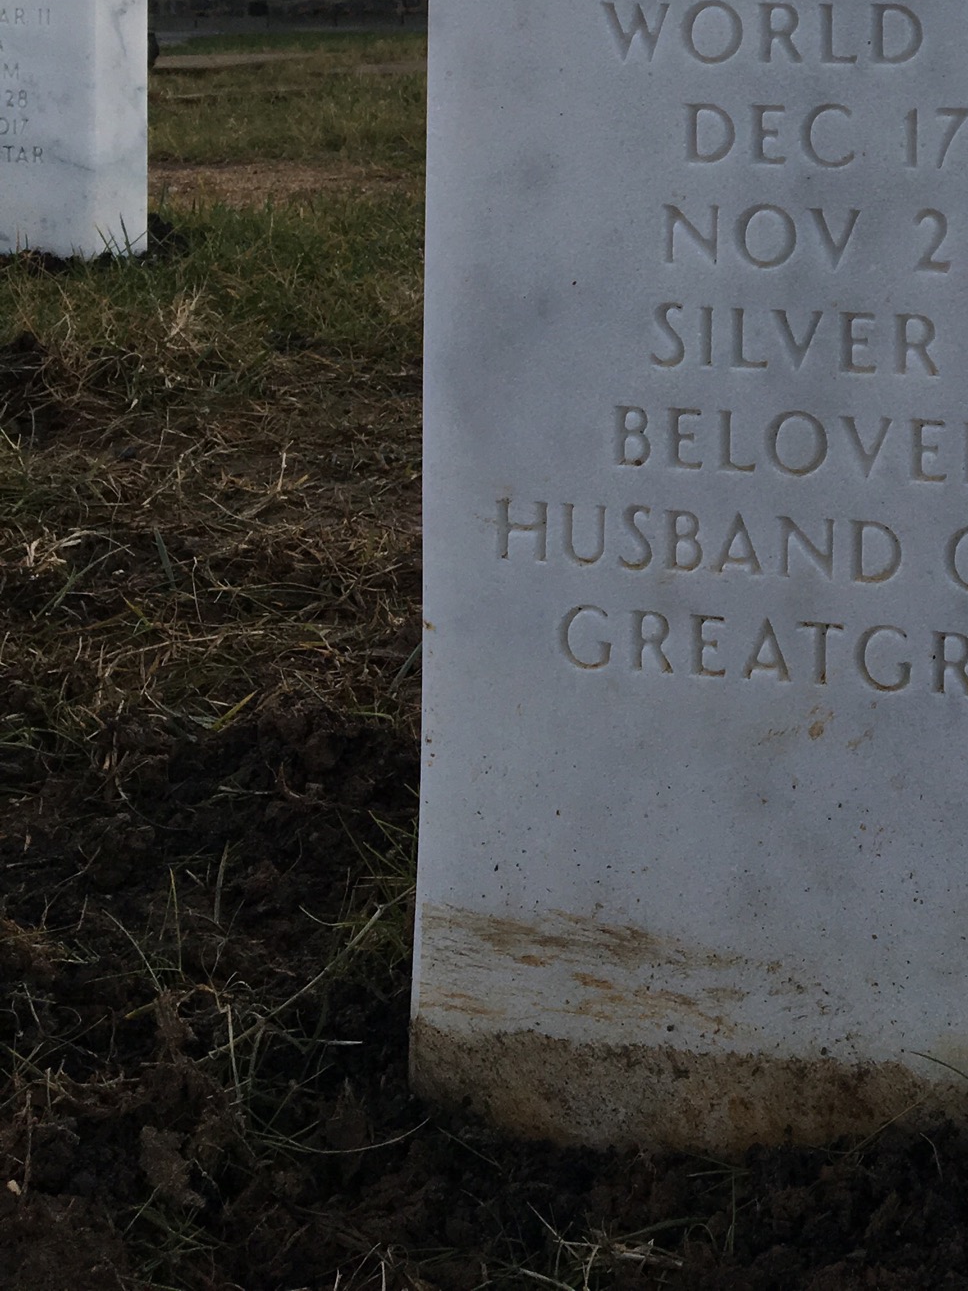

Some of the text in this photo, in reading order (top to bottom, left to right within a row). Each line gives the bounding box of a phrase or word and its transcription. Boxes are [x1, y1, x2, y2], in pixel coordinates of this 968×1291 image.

[683, 102, 856, 169] DEC
[662, 202, 861, 270] NOV
[912, 208, 950, 273] 2
[650, 301, 941, 377] SILVER
[496, 497, 903, 586] HUSBAND
